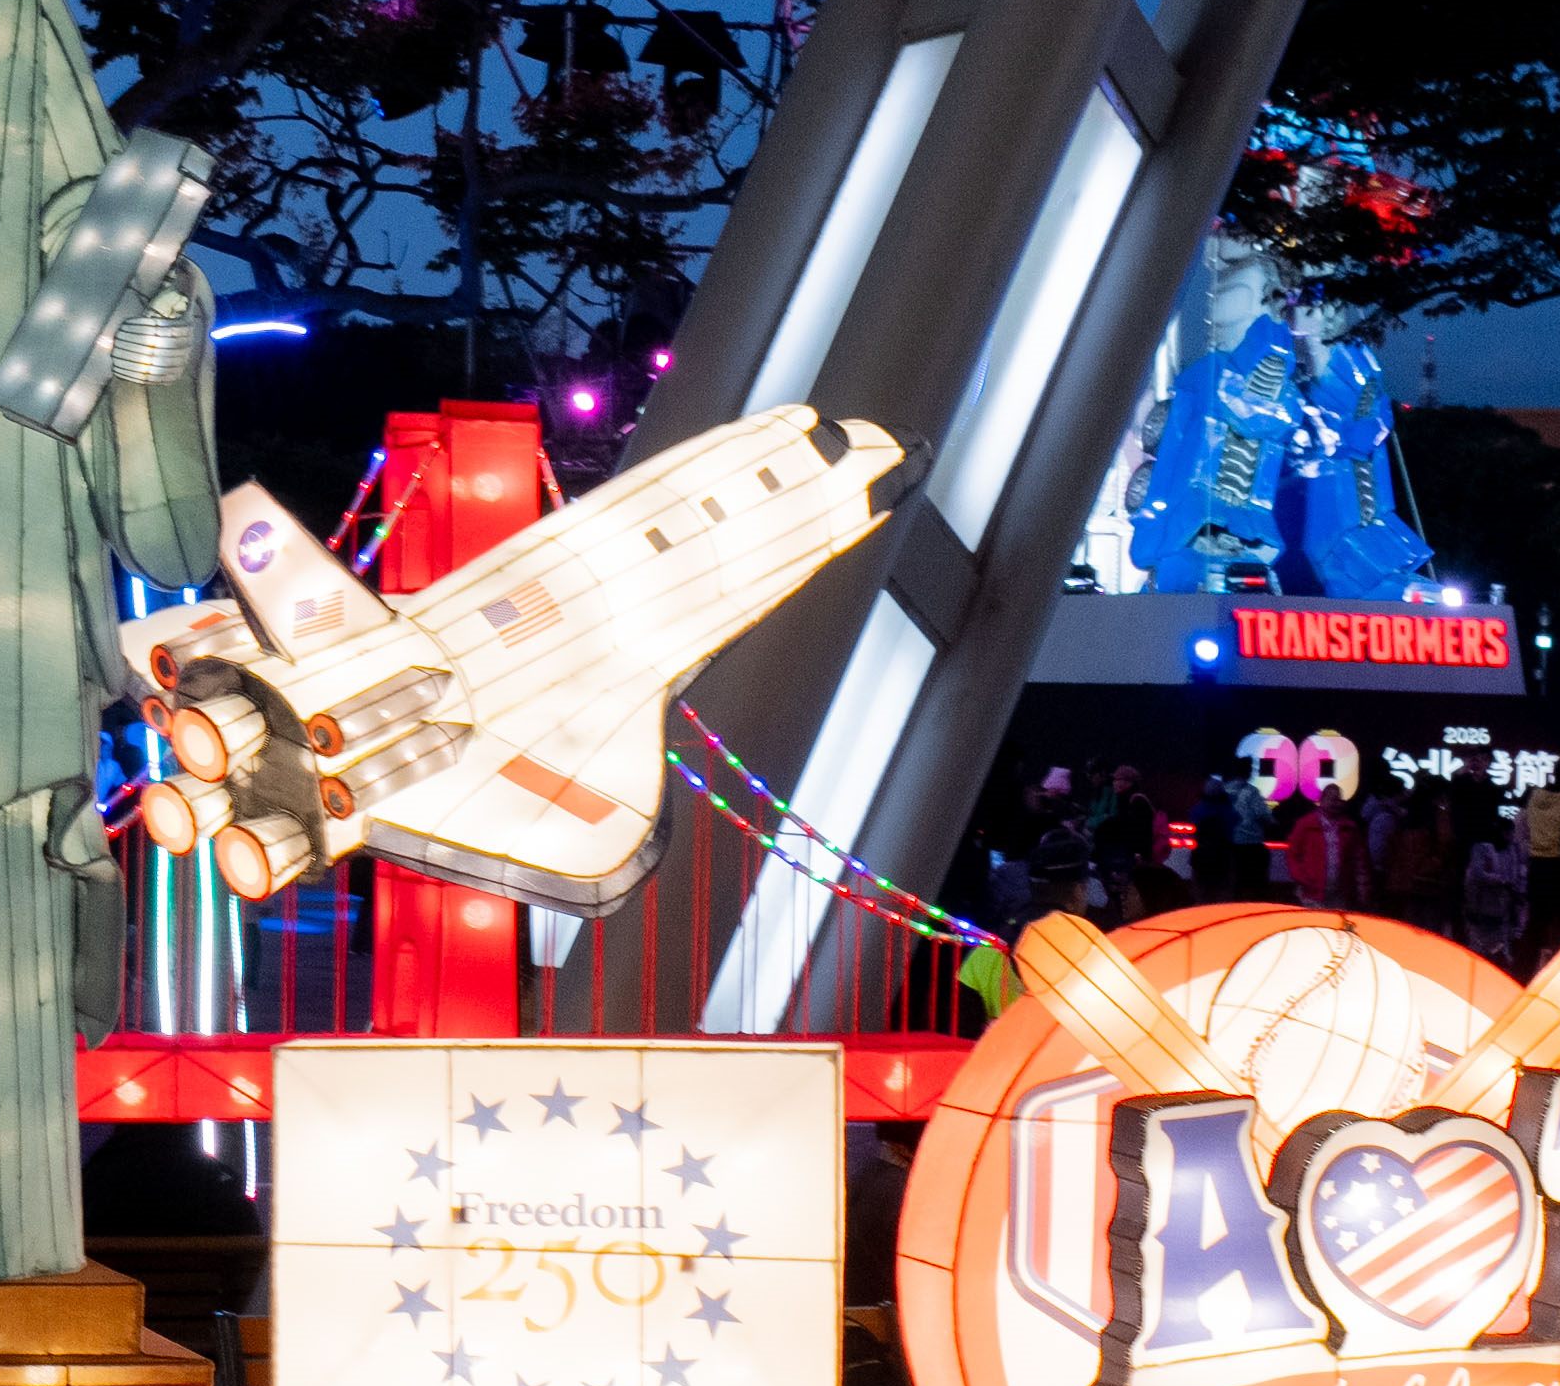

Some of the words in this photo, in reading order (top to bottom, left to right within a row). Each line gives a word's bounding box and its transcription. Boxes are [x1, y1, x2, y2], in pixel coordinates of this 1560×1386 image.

[1232, 608, 1509, 668] TRANSFORMERS
[453, 1192, 666, 1229] Freedom
[460, 1236, 666, 1332] 250
